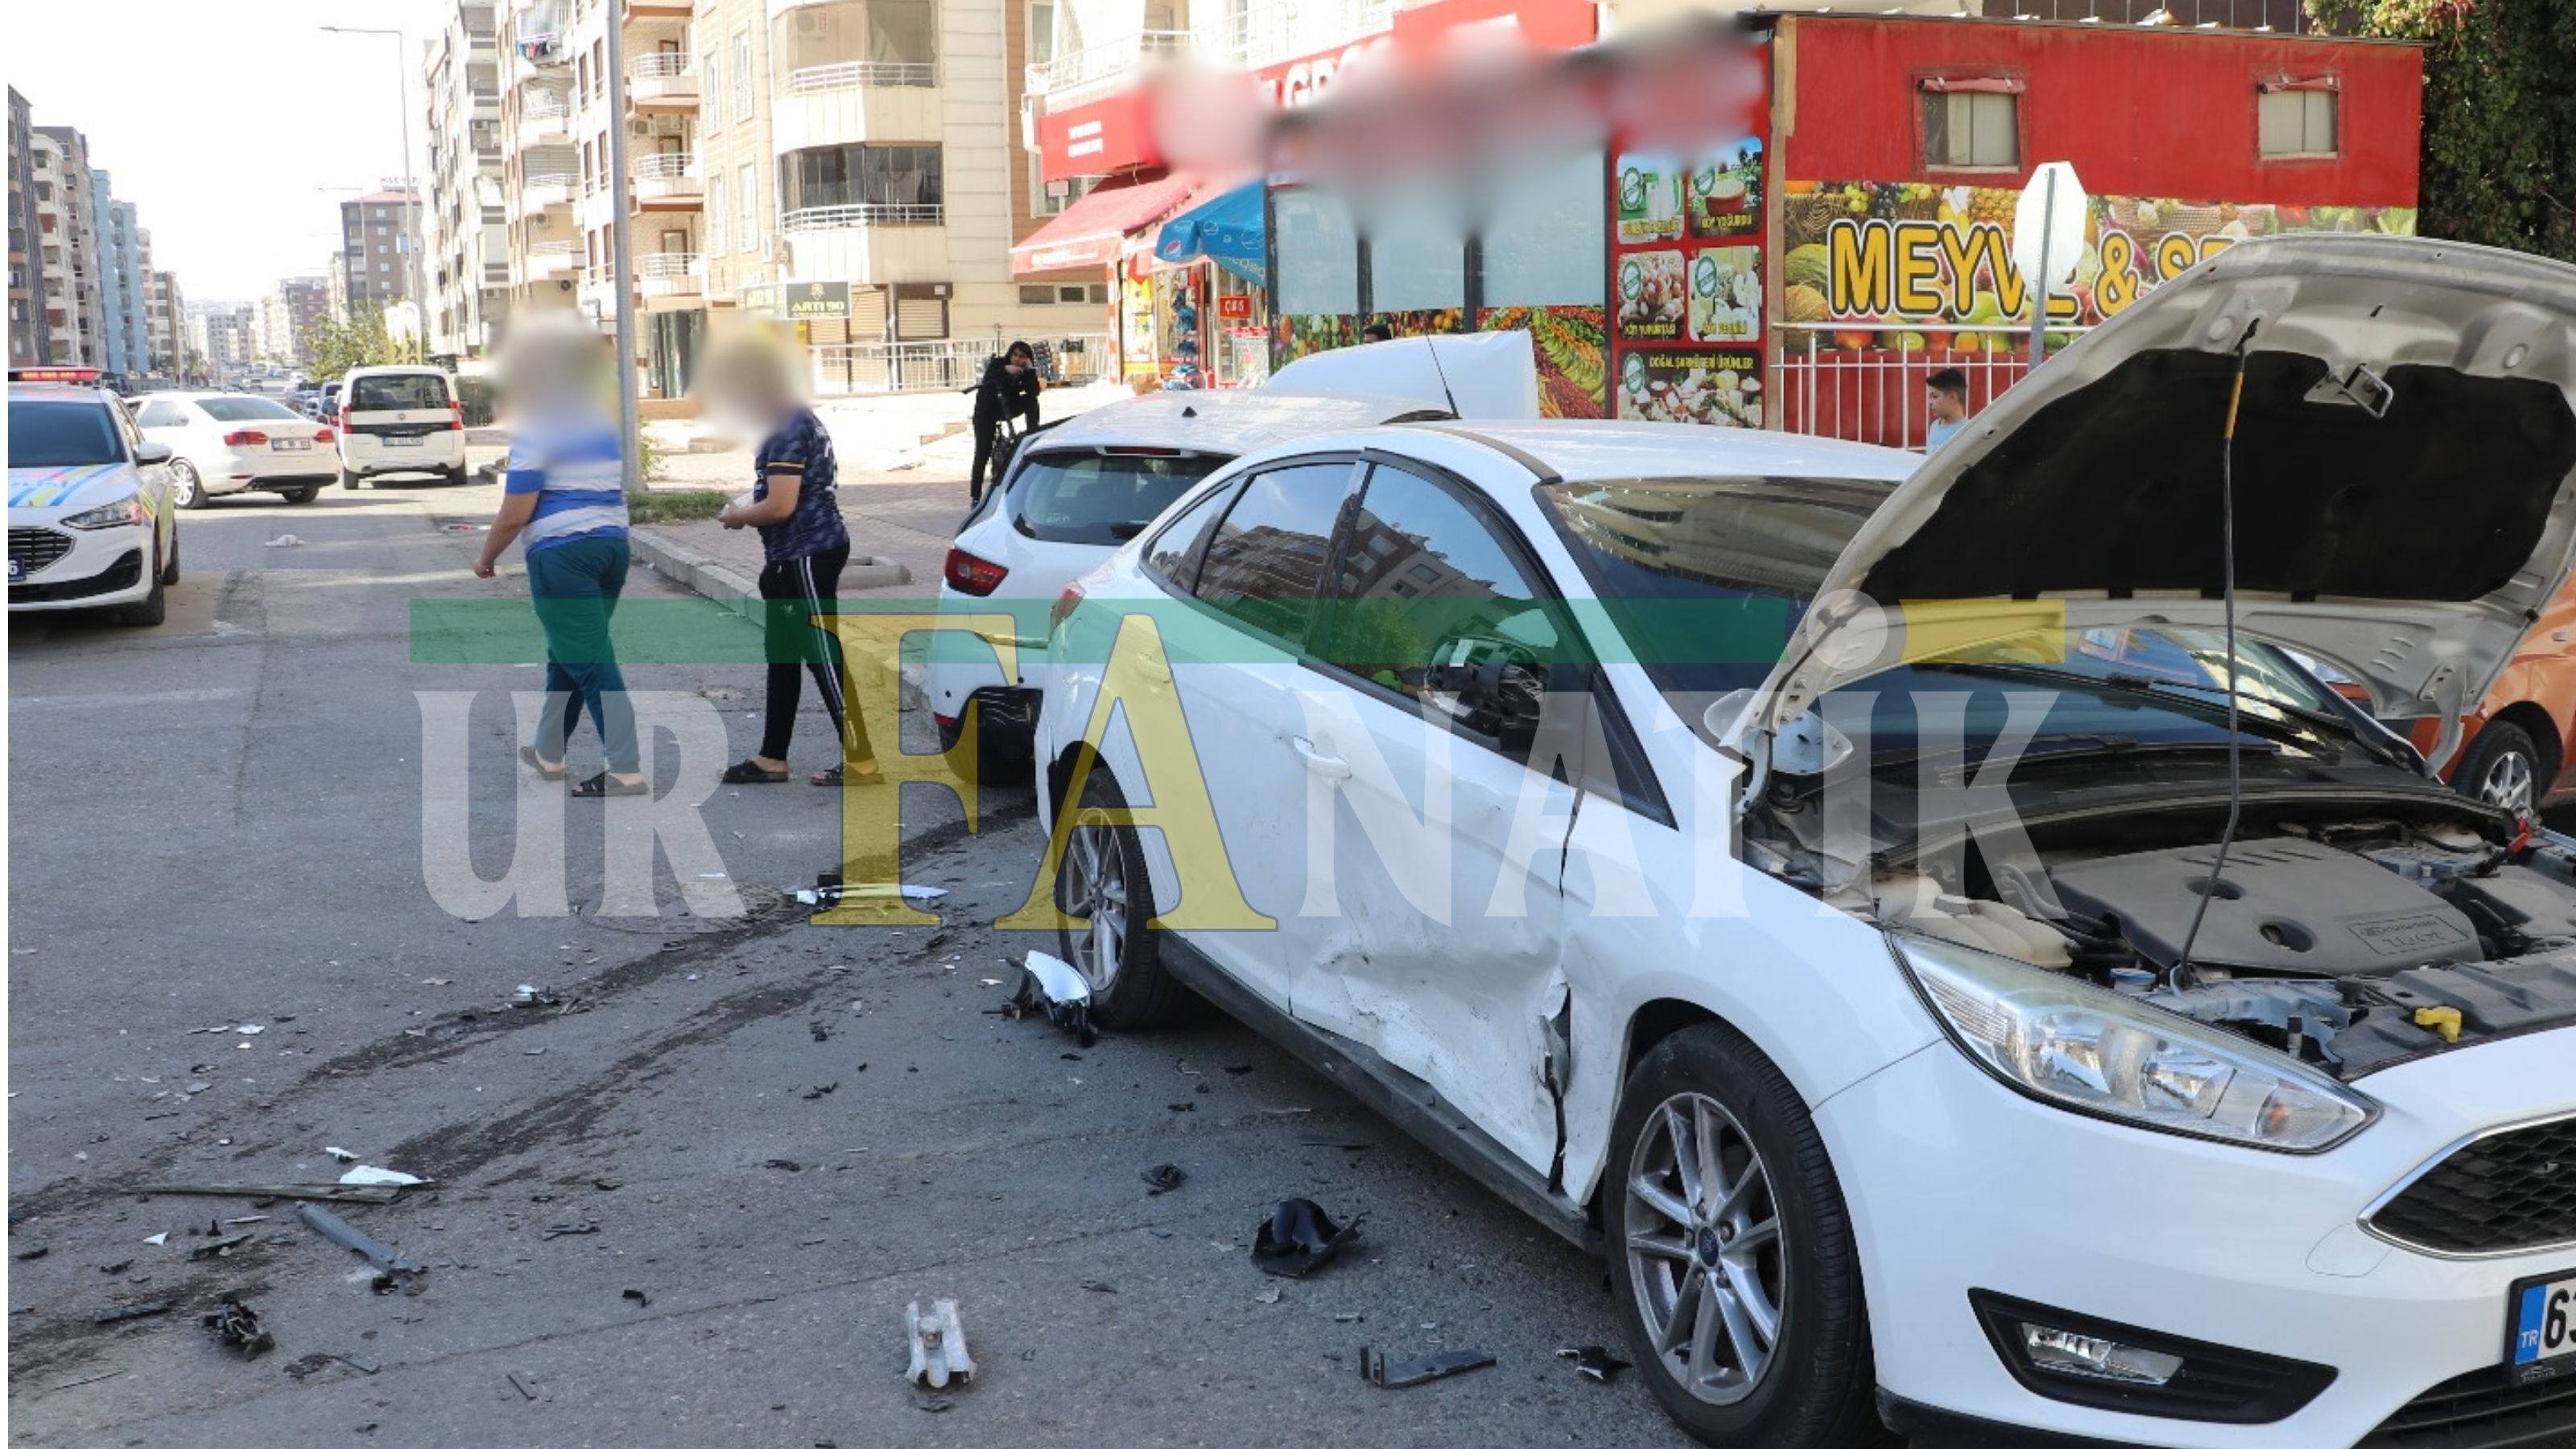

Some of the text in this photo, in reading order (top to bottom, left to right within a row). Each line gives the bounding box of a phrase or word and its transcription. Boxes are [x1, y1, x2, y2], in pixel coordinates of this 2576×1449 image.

[1830, 220, 2079, 320] MEYV
[2092, 229, 2136, 318] &
[2520, 1329, 2539, 1348] TR
